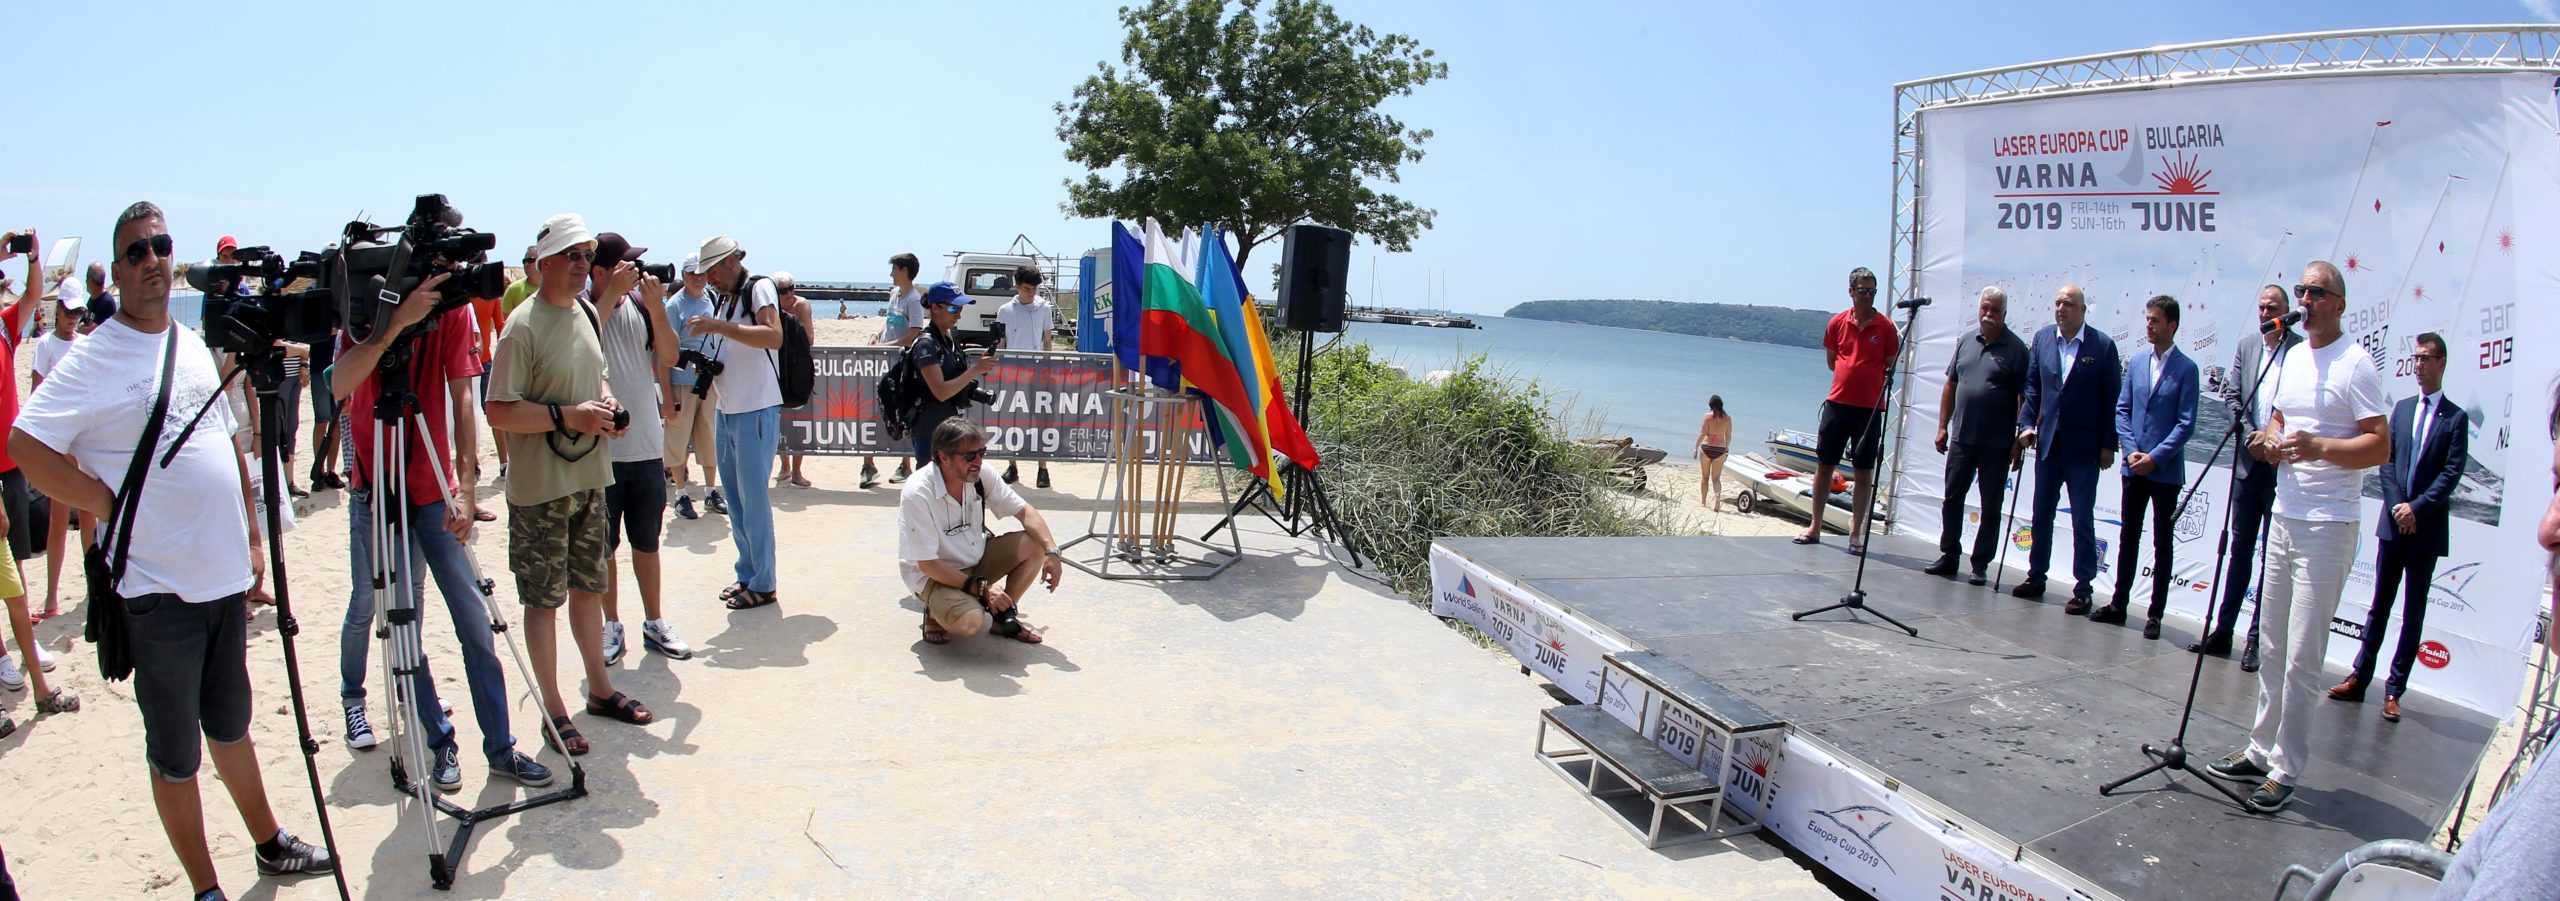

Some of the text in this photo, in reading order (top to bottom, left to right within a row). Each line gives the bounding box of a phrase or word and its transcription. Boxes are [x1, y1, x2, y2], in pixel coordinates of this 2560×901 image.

[1994, 128, 2129, 157] LASER EUROPA CUP
[2146, 123, 2224, 150] BULGARIA
[1995, 162, 2098, 189] VARNA
[1997, 201, 2216, 232] 2019 JUNE
[2070, 201, 2119, 215] FRI-14th
[2070, 216, 2126, 230] SUN-16th
[812, 359, 890, 377] BULGARIA
[989, 389, 1104, 416] VARNA
[792, 420, 877, 445] JUNE
[985, 426, 1060, 453] 2019
[2354, 560, 2375, 572] arna
[1492, 595, 1527, 627] VARNA
[2450, 601, 2465, 612] 2019
[1492, 616, 1514, 642] 2019
[1534, 642, 1567, 675] JUNE
[1659, 721, 1695, 756] 2019
[1807, 819, 1879, 868] Europa Cup 2019
[1942, 848, 2035, 901] LASER EUROPA
